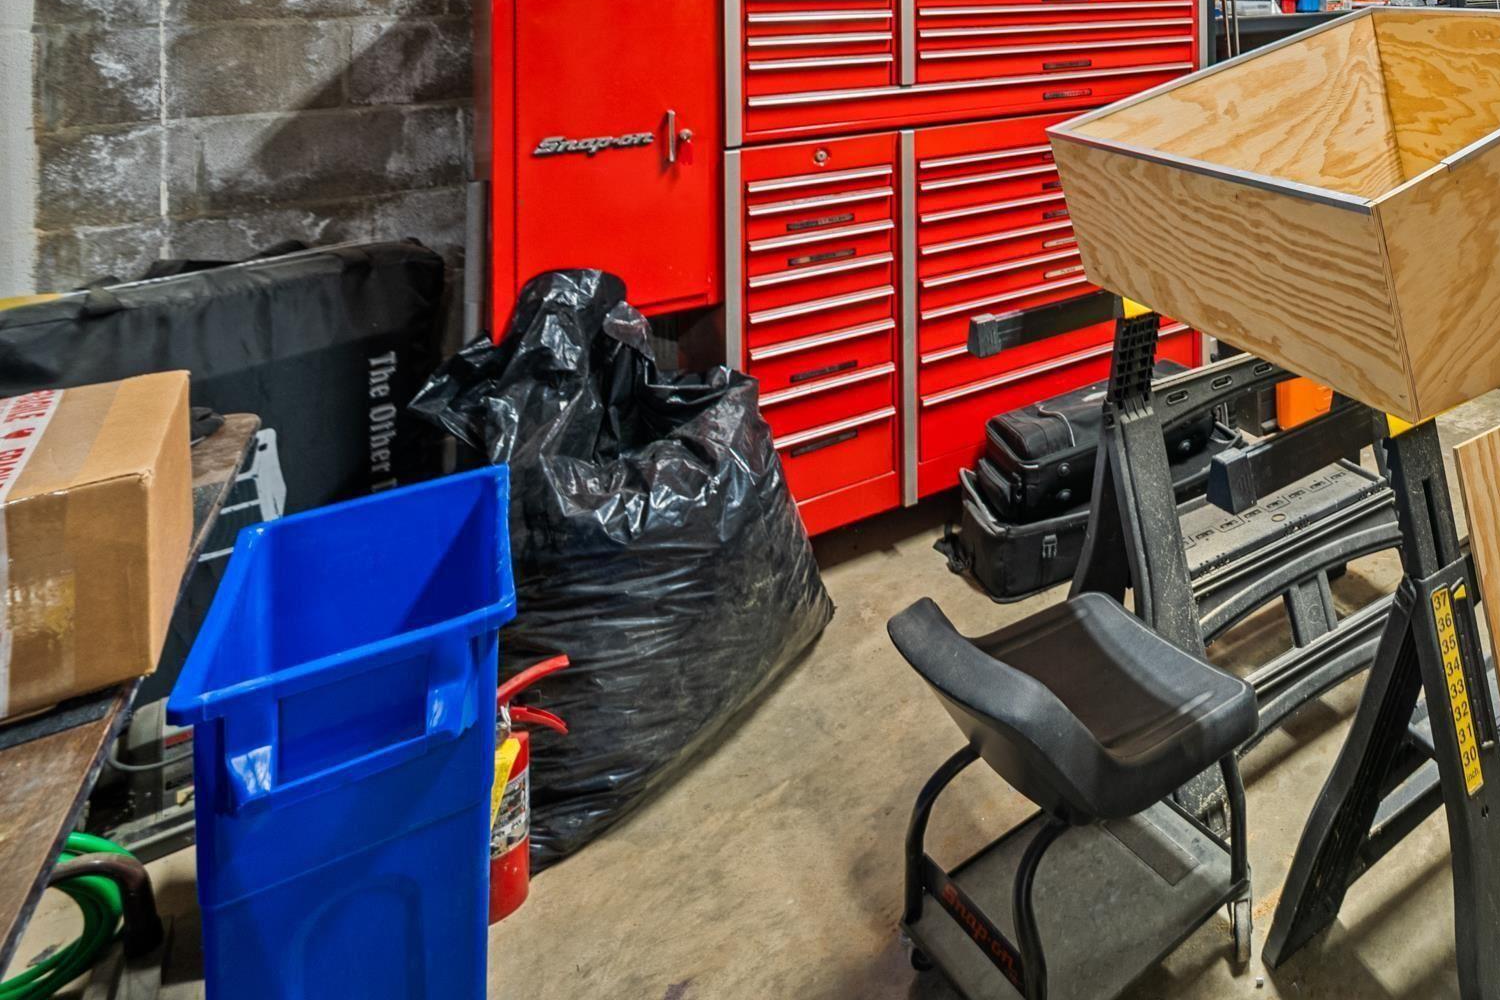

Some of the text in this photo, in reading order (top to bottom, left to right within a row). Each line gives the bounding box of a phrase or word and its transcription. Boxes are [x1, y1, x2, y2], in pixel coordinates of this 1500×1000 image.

[533, 132, 655, 155] Snap-on
[368, 351, 396, 397] The
[369, 403, 397, 472] Other
[1433, 590, 1448, 611] 37
[1437, 616, 1452, 633] 36
[1442, 635, 1456, 655] 35
[1446, 658, 1460, 676] 34
[1450, 679, 1464, 698] 33
[1454, 701, 1469, 721] 32
[1458, 724, 1473, 744] 31
[1463, 746, 1476, 767] 30
